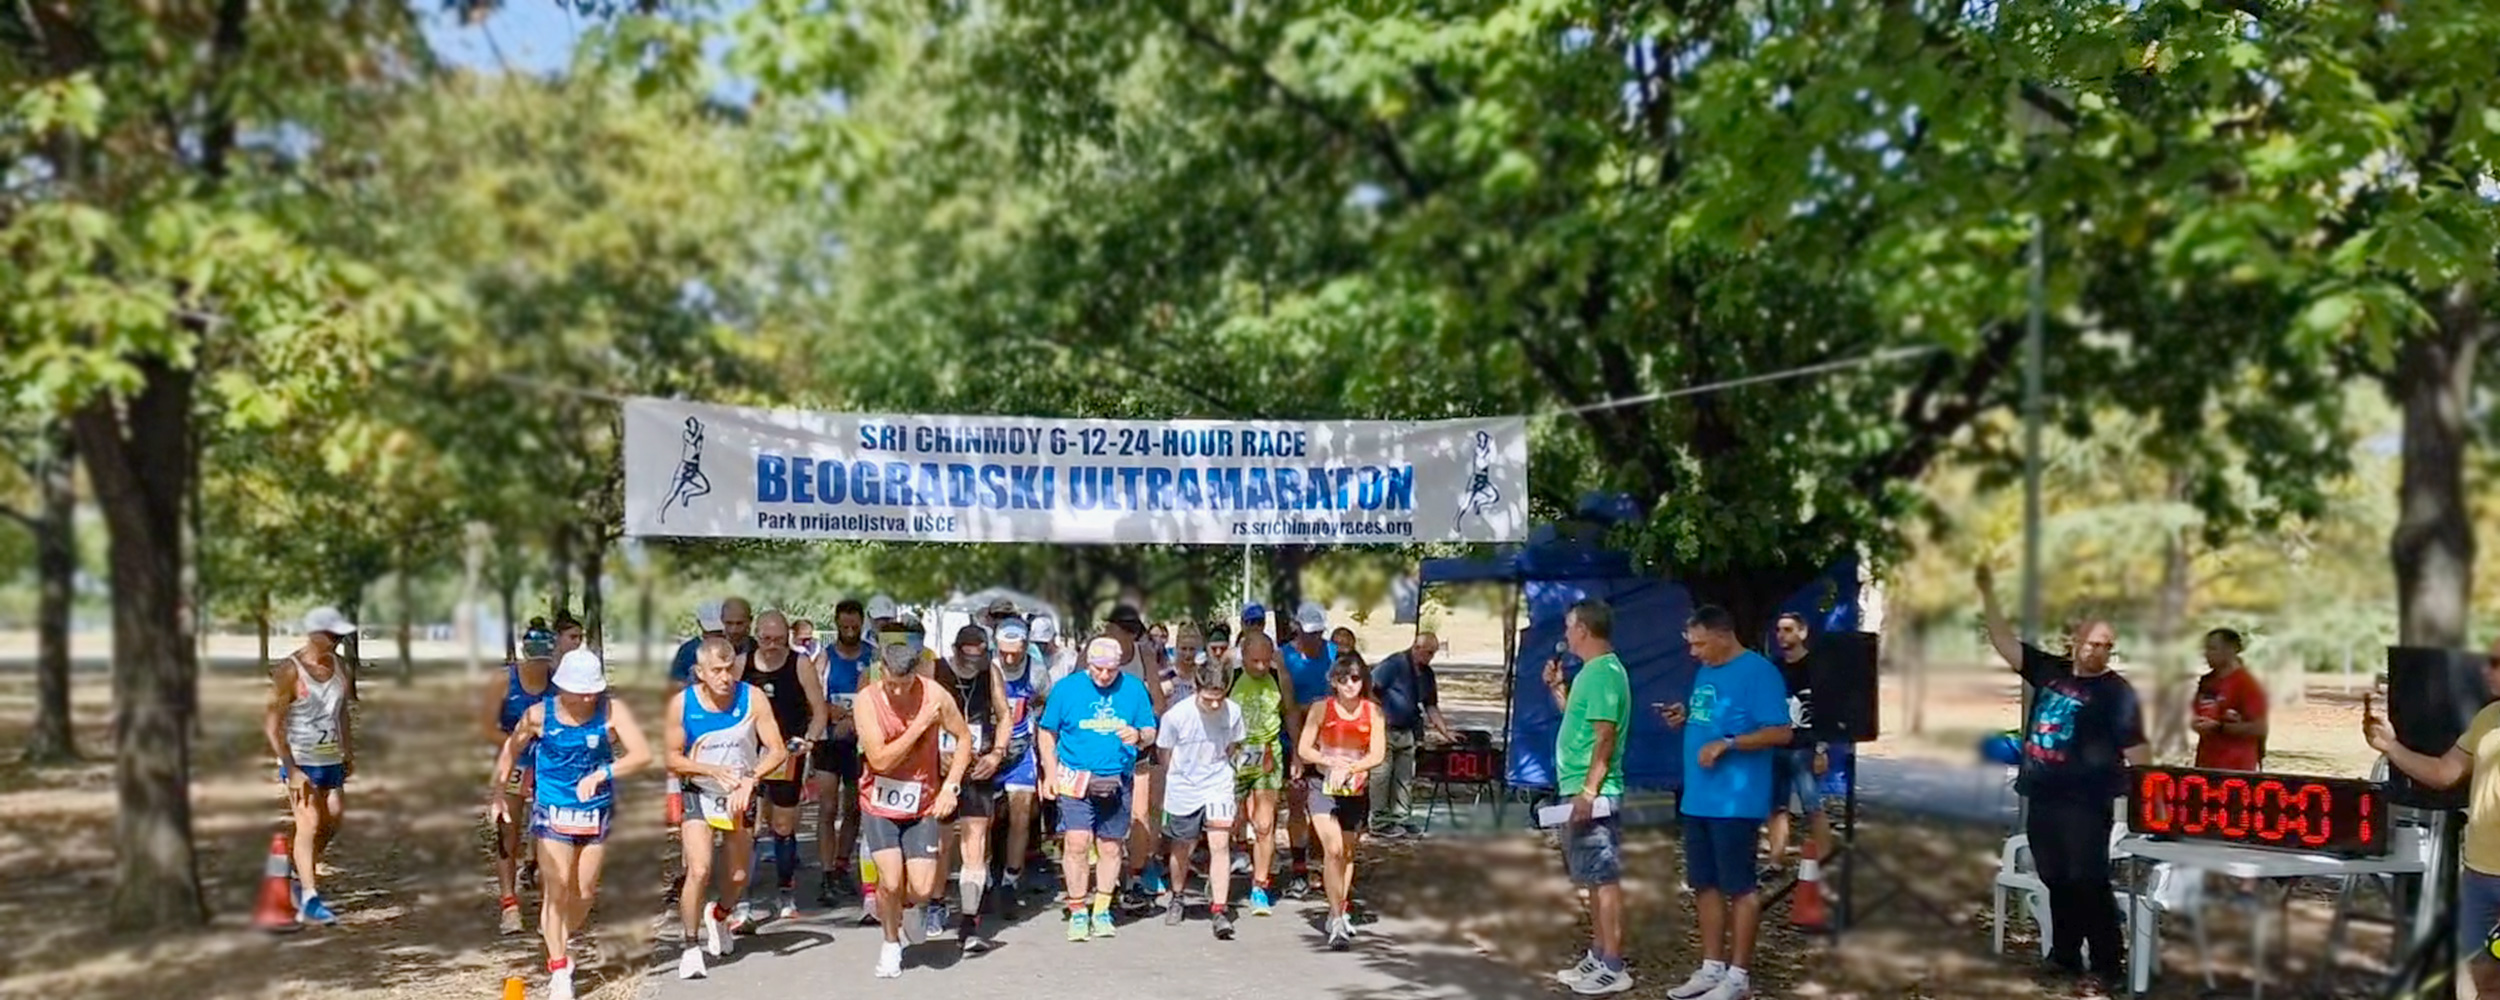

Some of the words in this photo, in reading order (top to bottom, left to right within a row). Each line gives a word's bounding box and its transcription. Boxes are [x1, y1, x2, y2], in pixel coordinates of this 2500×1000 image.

[860, 424, 907, 452] SRI
[915, 426, 1043, 456] CHINMOY
[1050, 427, 1234, 458] 6-12-24-HOUR
[1241, 430, 1306, 459] RACE
[757, 453, 1055, 510] BEOGRADSKI
[1069, 464, 1414, 512] ULTRAMARATON
[757, 511, 797, 530] Park
[800, 513, 909, 534] prijateljstva,
[876, 786, 916, 809] 109
